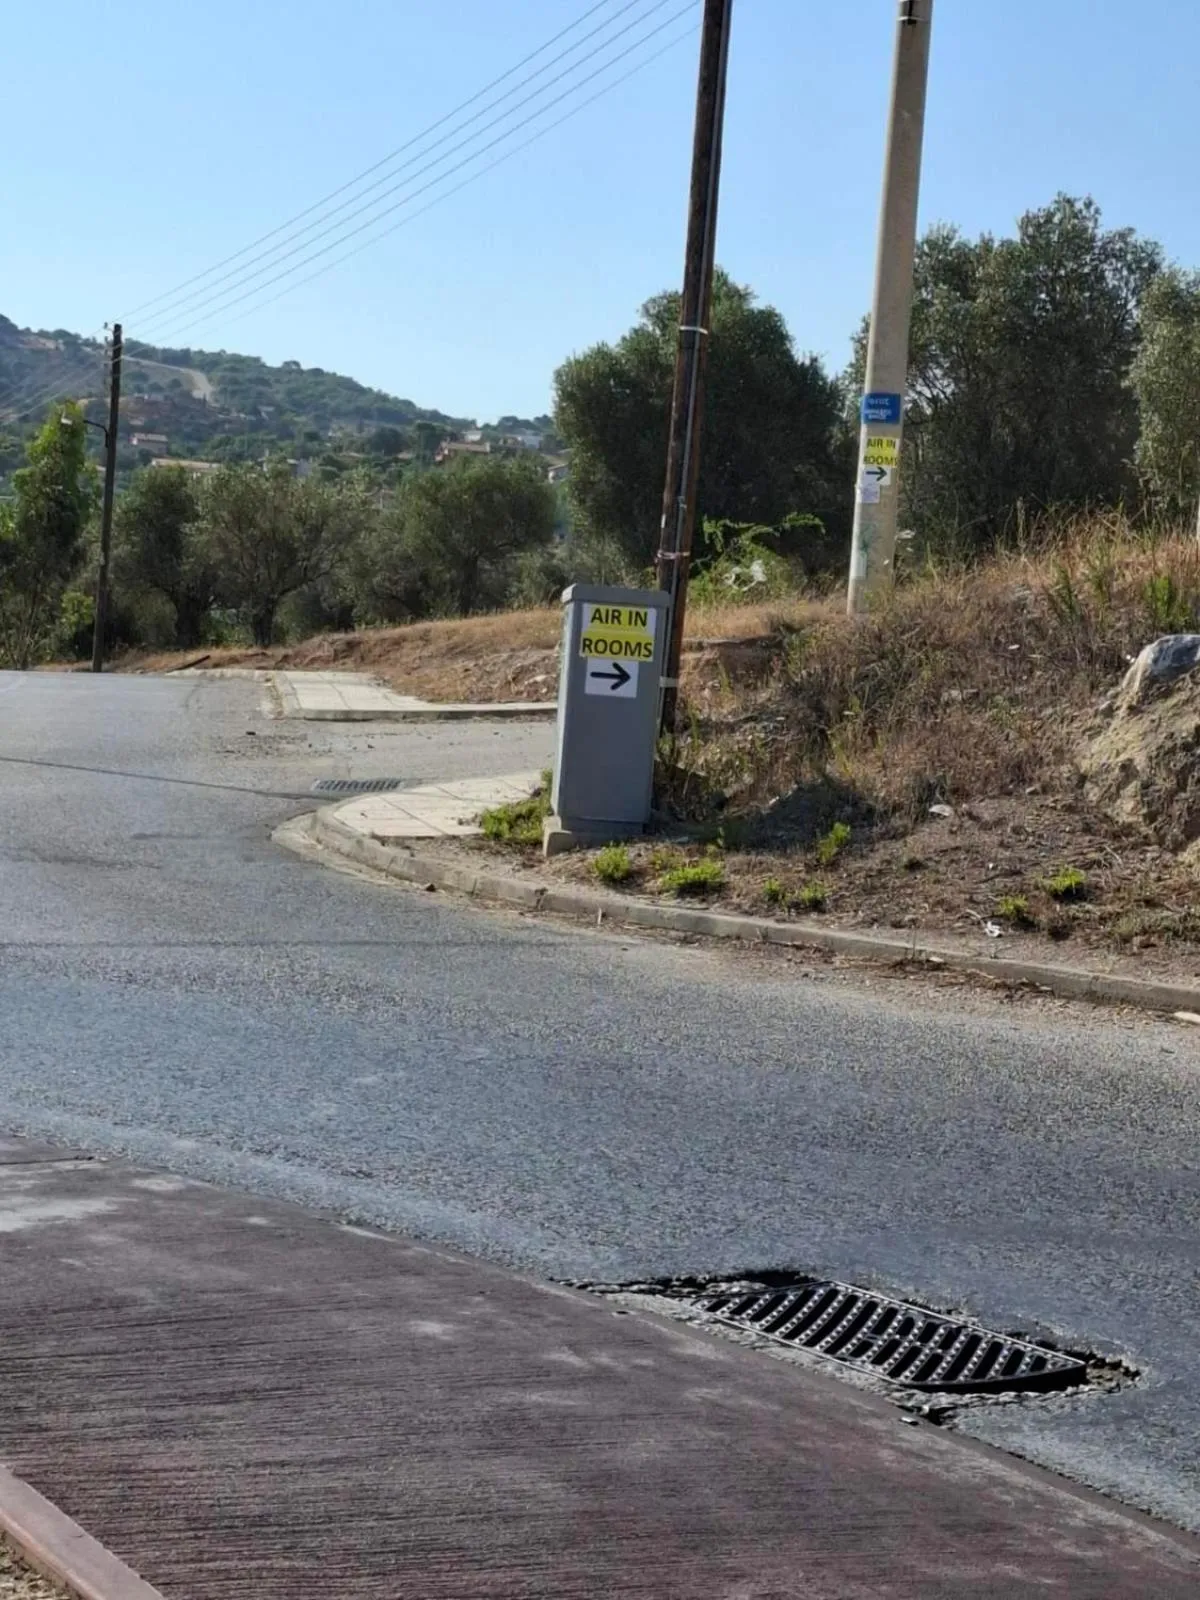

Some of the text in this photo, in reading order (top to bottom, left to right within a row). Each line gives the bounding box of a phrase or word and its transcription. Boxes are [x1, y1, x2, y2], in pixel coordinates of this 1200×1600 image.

[867, 438, 896, 449] AIR IN
[590, 608, 648, 627] AIR IN
[582, 637, 653, 658] ROOMS
